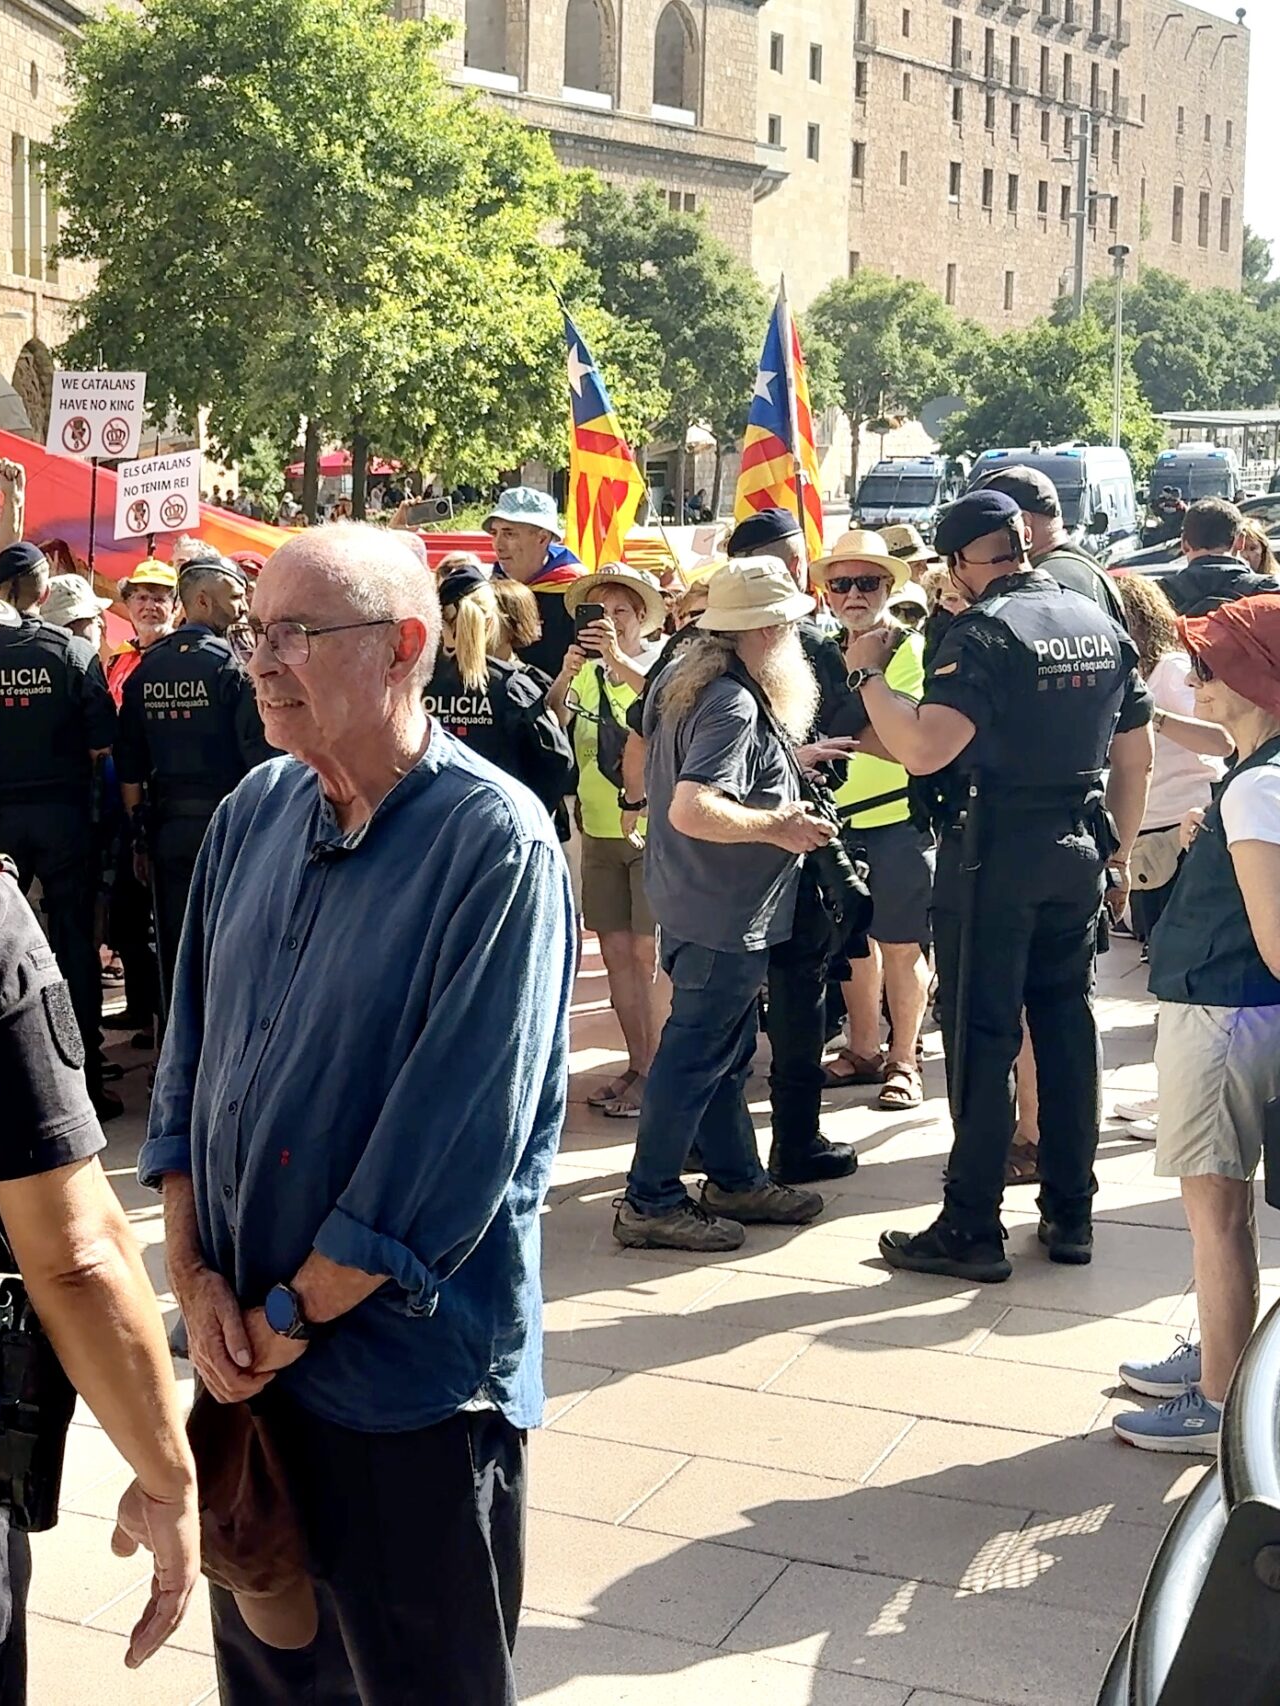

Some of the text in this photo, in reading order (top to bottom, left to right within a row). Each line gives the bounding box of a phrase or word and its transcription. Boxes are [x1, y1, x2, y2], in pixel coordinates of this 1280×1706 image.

[61, 378, 136, 390] WE CATALANS
[59, 399, 135, 411] HAVE NO KING
[123, 456, 191, 478] ELS CATALANS
[123, 477, 189, 497] NO TENIM REI
[1033, 634, 1114, 662] POLICIA
[1038, 663, 1072, 676] mossos
[143, 680, 208, 699] POLICIA
[422, 696, 493, 715] OLICIA
